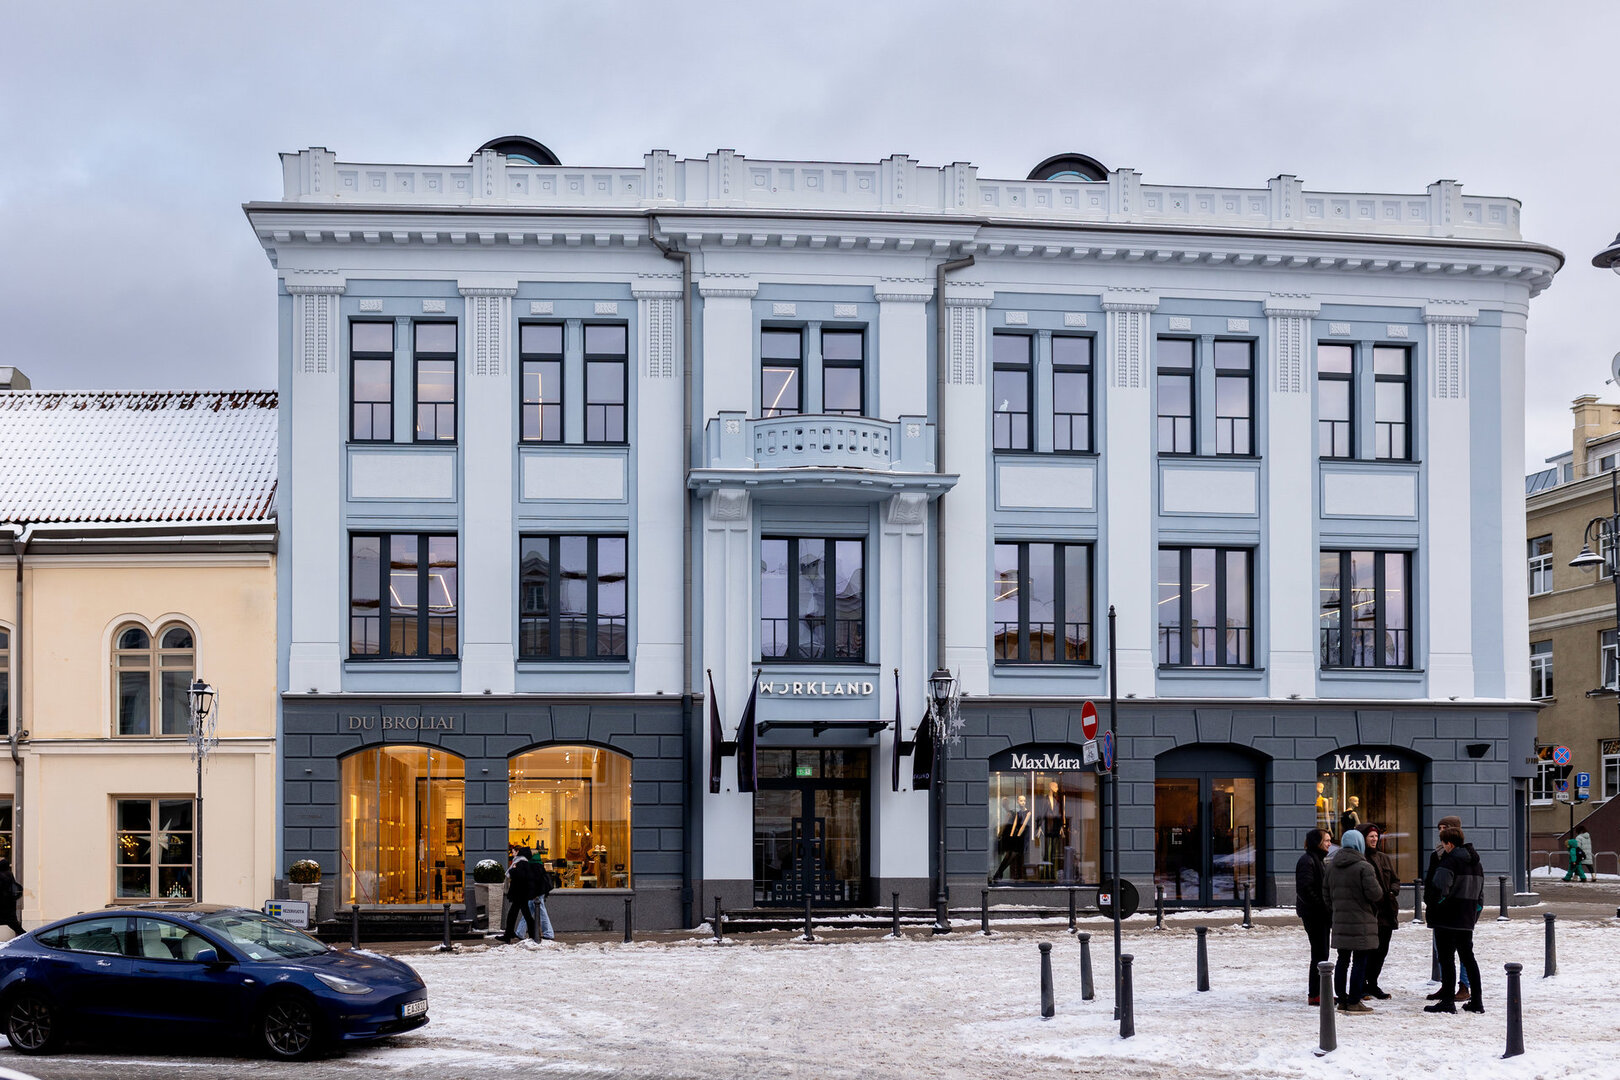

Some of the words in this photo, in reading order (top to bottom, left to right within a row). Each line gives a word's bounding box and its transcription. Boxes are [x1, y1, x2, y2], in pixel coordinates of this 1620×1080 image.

[759, 681, 874, 696] WORKLAND
[348, 715, 375, 730] DU
[382, 716, 455, 730] BROLIAI
[1010, 753, 1081, 770] MaxMara
[1333, 754, 1400, 770] MaxMara
